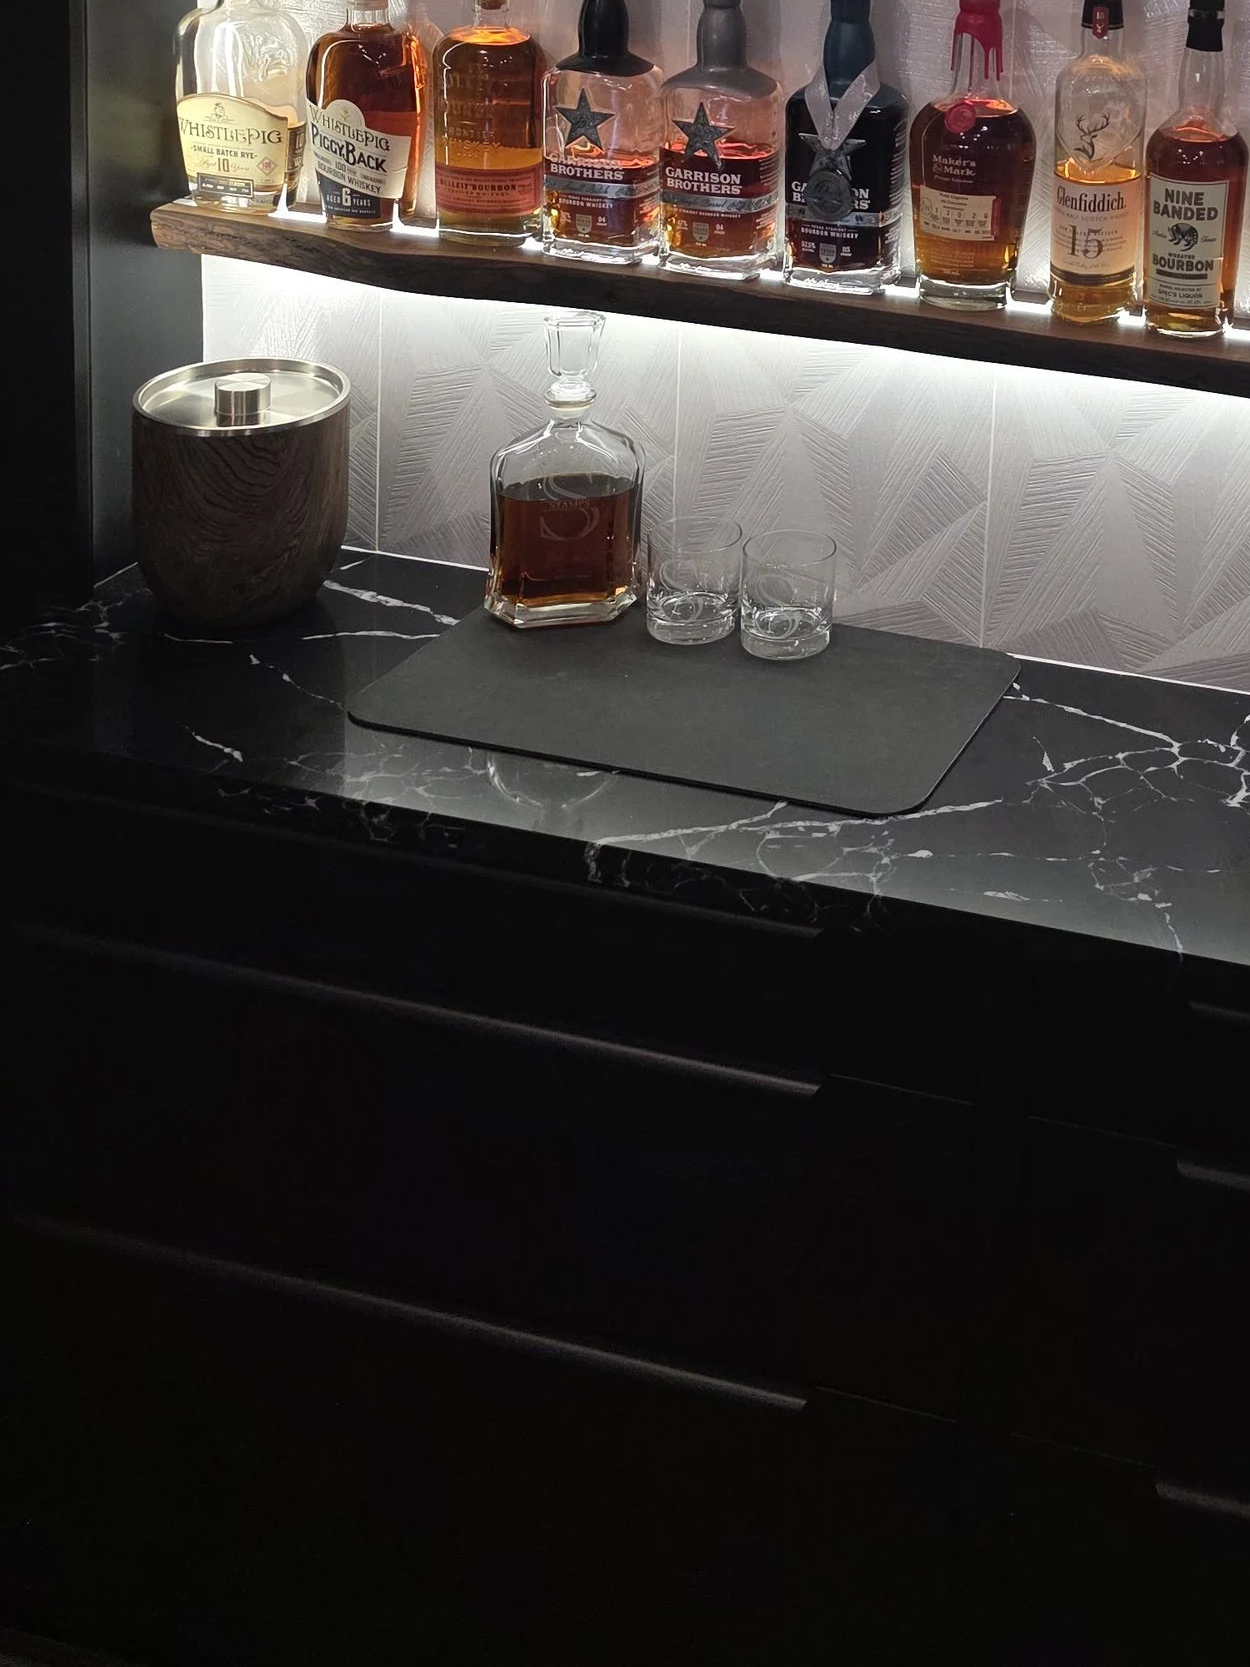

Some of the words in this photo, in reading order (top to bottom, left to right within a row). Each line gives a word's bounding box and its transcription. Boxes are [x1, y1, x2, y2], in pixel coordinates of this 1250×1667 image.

[180, 117, 282, 146] WHISTLEPIG
[309, 105, 390, 152] WHISTLEPIG
[216, 149, 239, 158] BATCH
[932, 154, 976, 167] Maker's
[217, 157, 230, 172] 10
[335, 160, 347, 173] 100
[550, 163, 625, 181] BROTHERS
[347, 175, 381, 194] WHISKEY
[665, 167, 741, 185] GARRISON
[471, 180, 517, 191] BOURBON
[666, 177, 743, 195] BROTHERS
[326, 194, 341, 204] AGED
[342, 187, 352, 207] 6
[353, 199, 371, 207] YEARS
[586, 201, 614, 209] WHISKEY
[1057, 185, 1127, 213] Glenfiddich
[1165, 188, 1205, 206] NINE
[1153, 200, 1219, 221] BANDED
[801, 227, 828, 237] BOURBON
[830, 231, 859, 239] WHISKEY
[1067, 224, 1104, 259] 15
[1152, 253, 1214, 272] BOURBON
[549, 498, 591, 509] STAMPS
